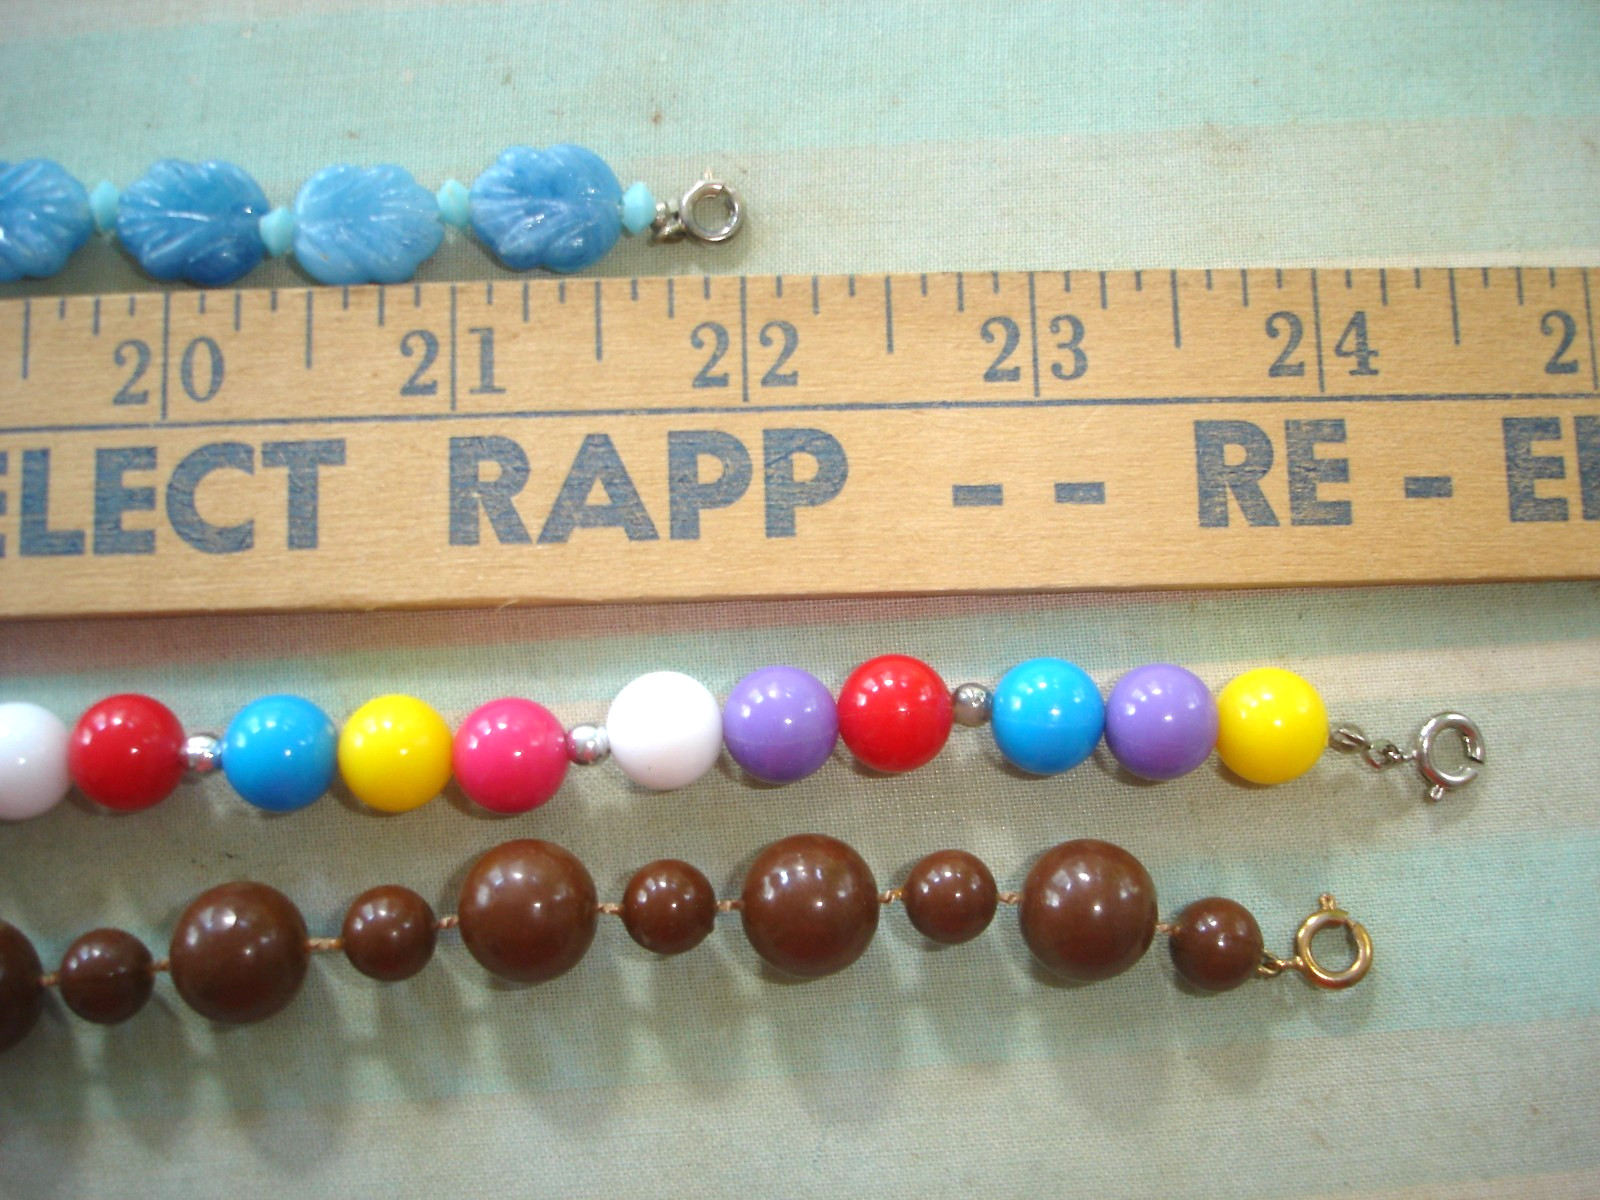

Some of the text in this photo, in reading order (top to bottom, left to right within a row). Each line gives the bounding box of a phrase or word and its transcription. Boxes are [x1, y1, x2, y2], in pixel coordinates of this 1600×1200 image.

[113, 336, 226, 406] 20
[399, 326, 507, 397] 21
[689, 319, 800, 389] 22
[980, 313, 1090, 383] 23
[1264, 310, 1380, 378] 24
[0, 437, 347, 559] LECT
[448, 427, 850, 546] RAPP
